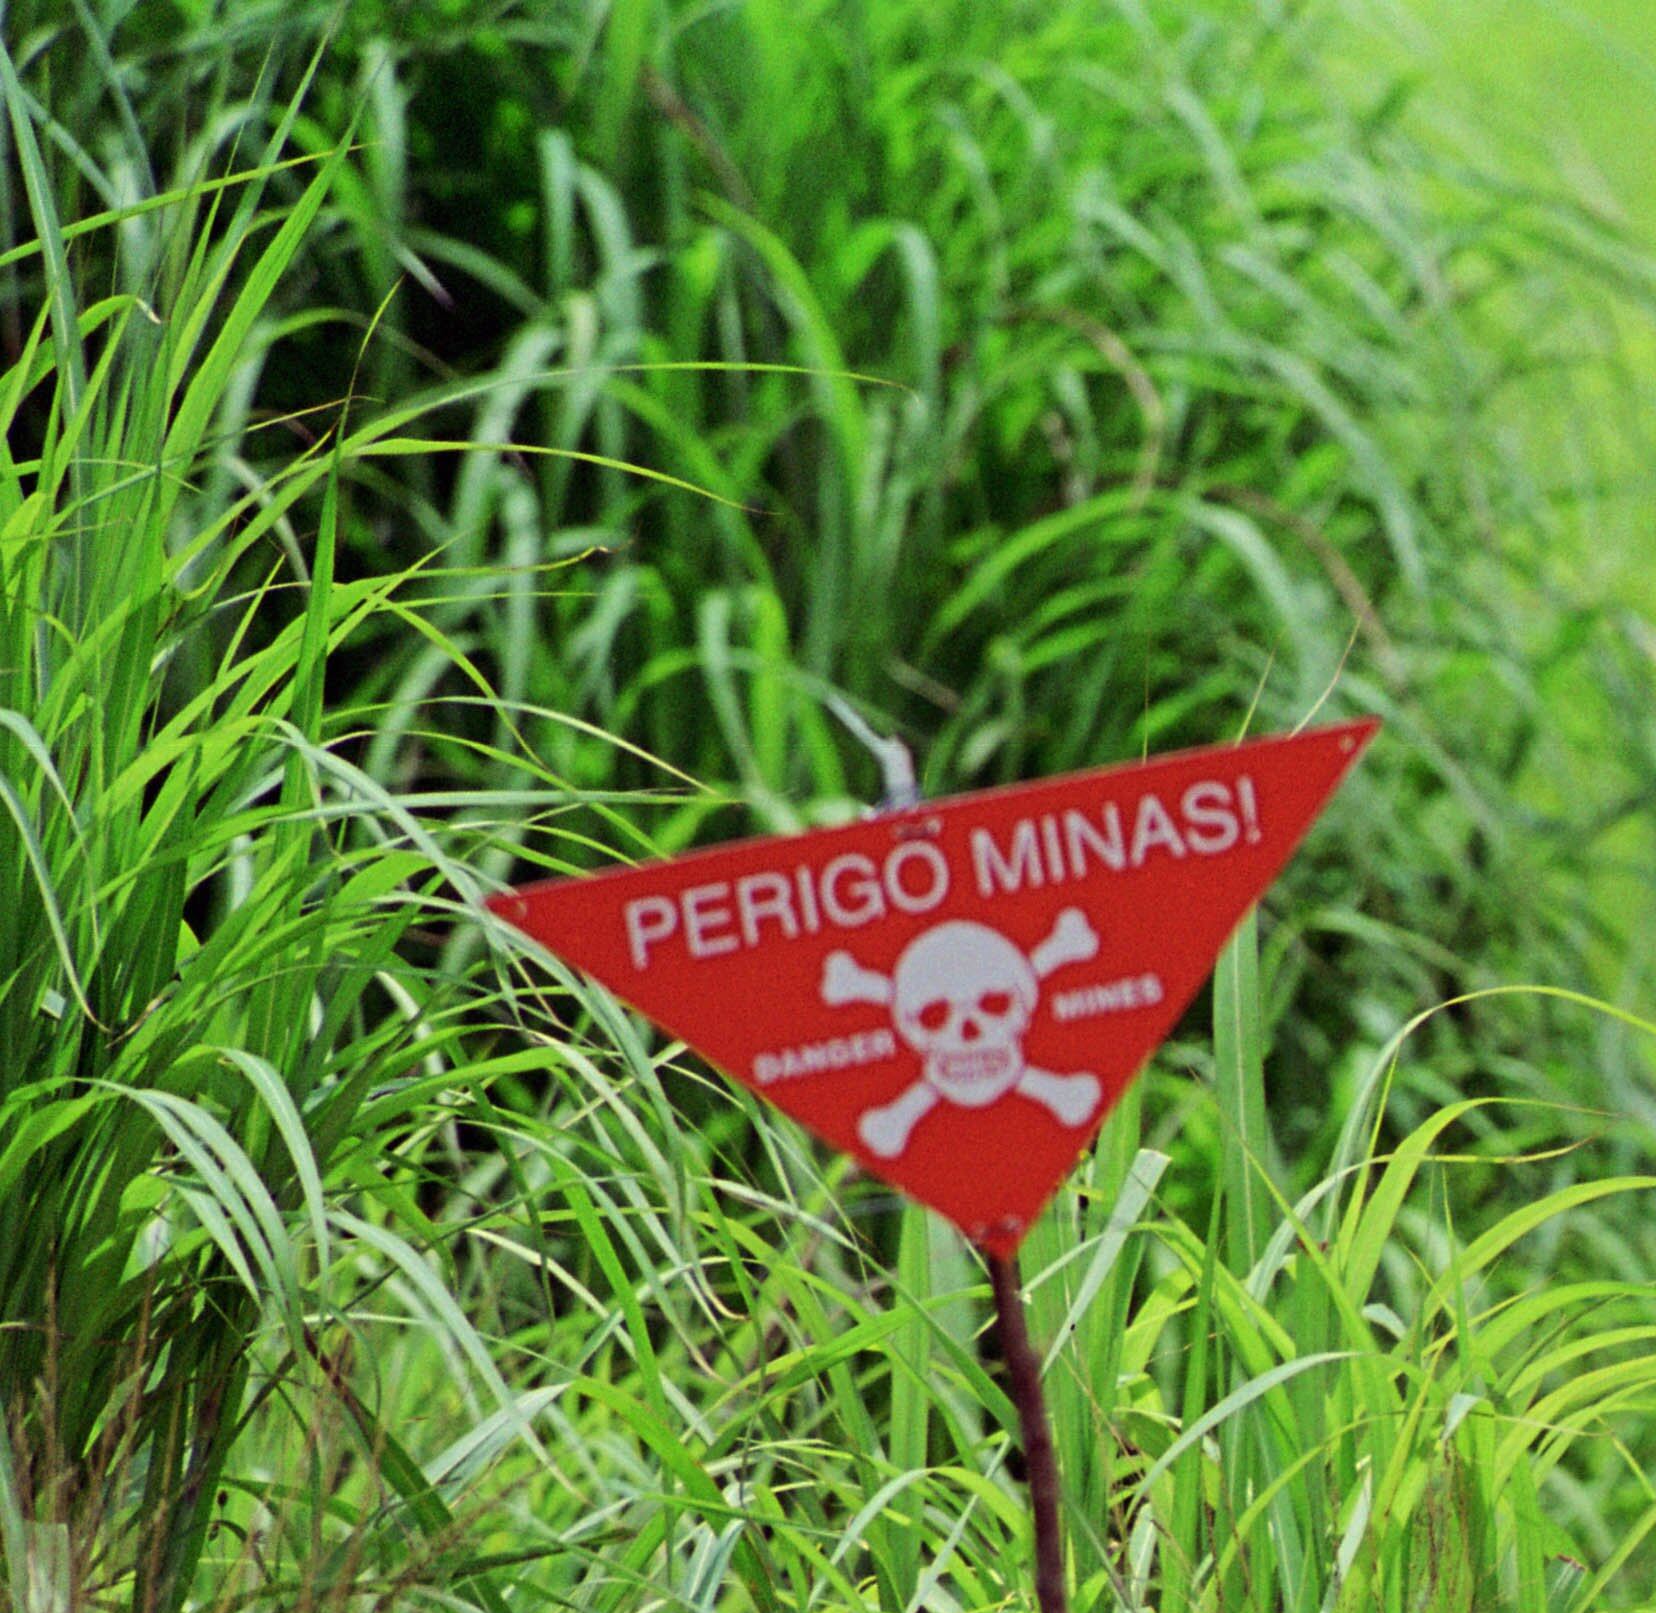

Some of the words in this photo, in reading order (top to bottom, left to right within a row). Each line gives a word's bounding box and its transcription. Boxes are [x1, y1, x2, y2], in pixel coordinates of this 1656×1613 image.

[624, 840, 951, 972] PERIGO
[971, 777, 1262, 898] MINAS!
[753, 1029, 896, 1084] DANGER
[1052, 972, 1164, 1022] MINES
